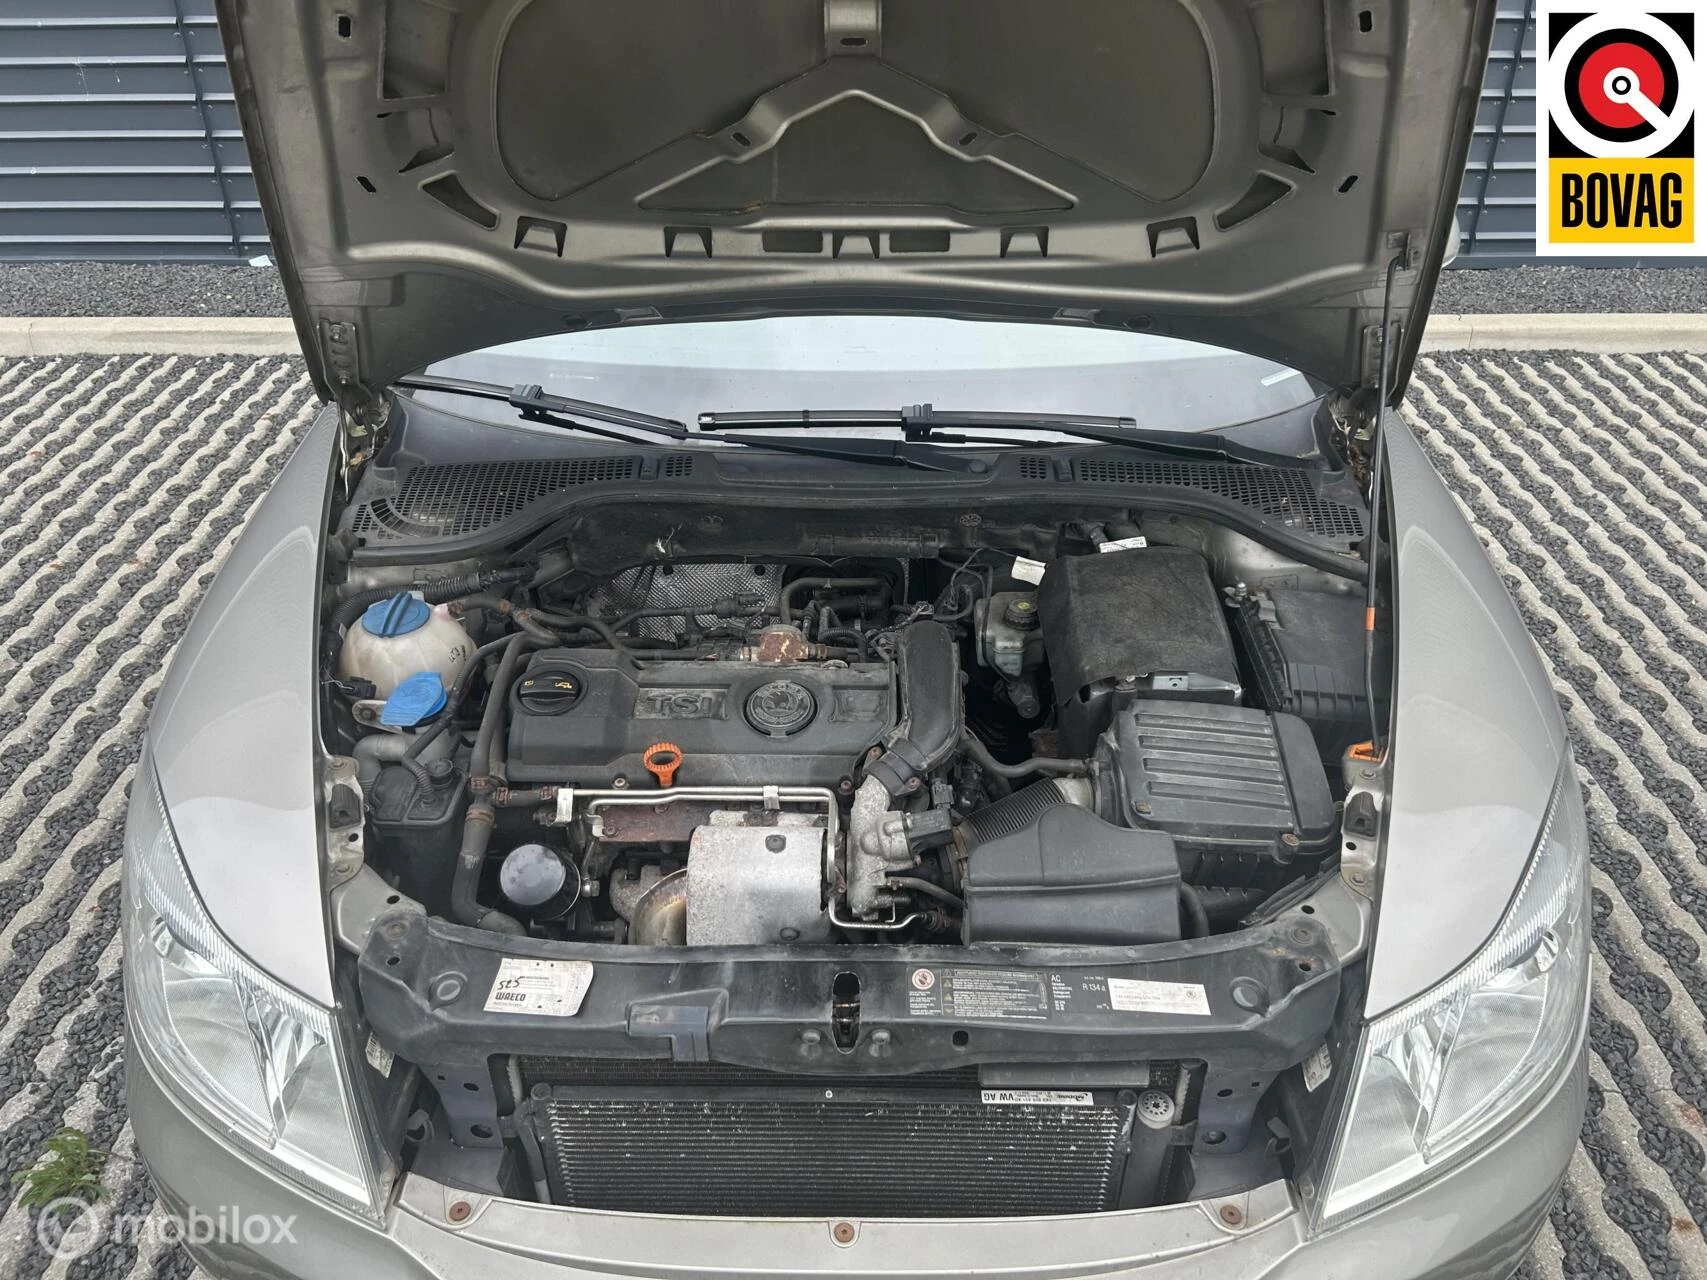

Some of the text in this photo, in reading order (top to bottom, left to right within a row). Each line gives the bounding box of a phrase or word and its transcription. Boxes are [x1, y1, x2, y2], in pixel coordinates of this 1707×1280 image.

[647, 694, 713, 715] TSI
[495, 992, 527, 1002] WAECO
[983, 1092, 996, 1101] AG
[999, 1092, 1014, 1102] VW
